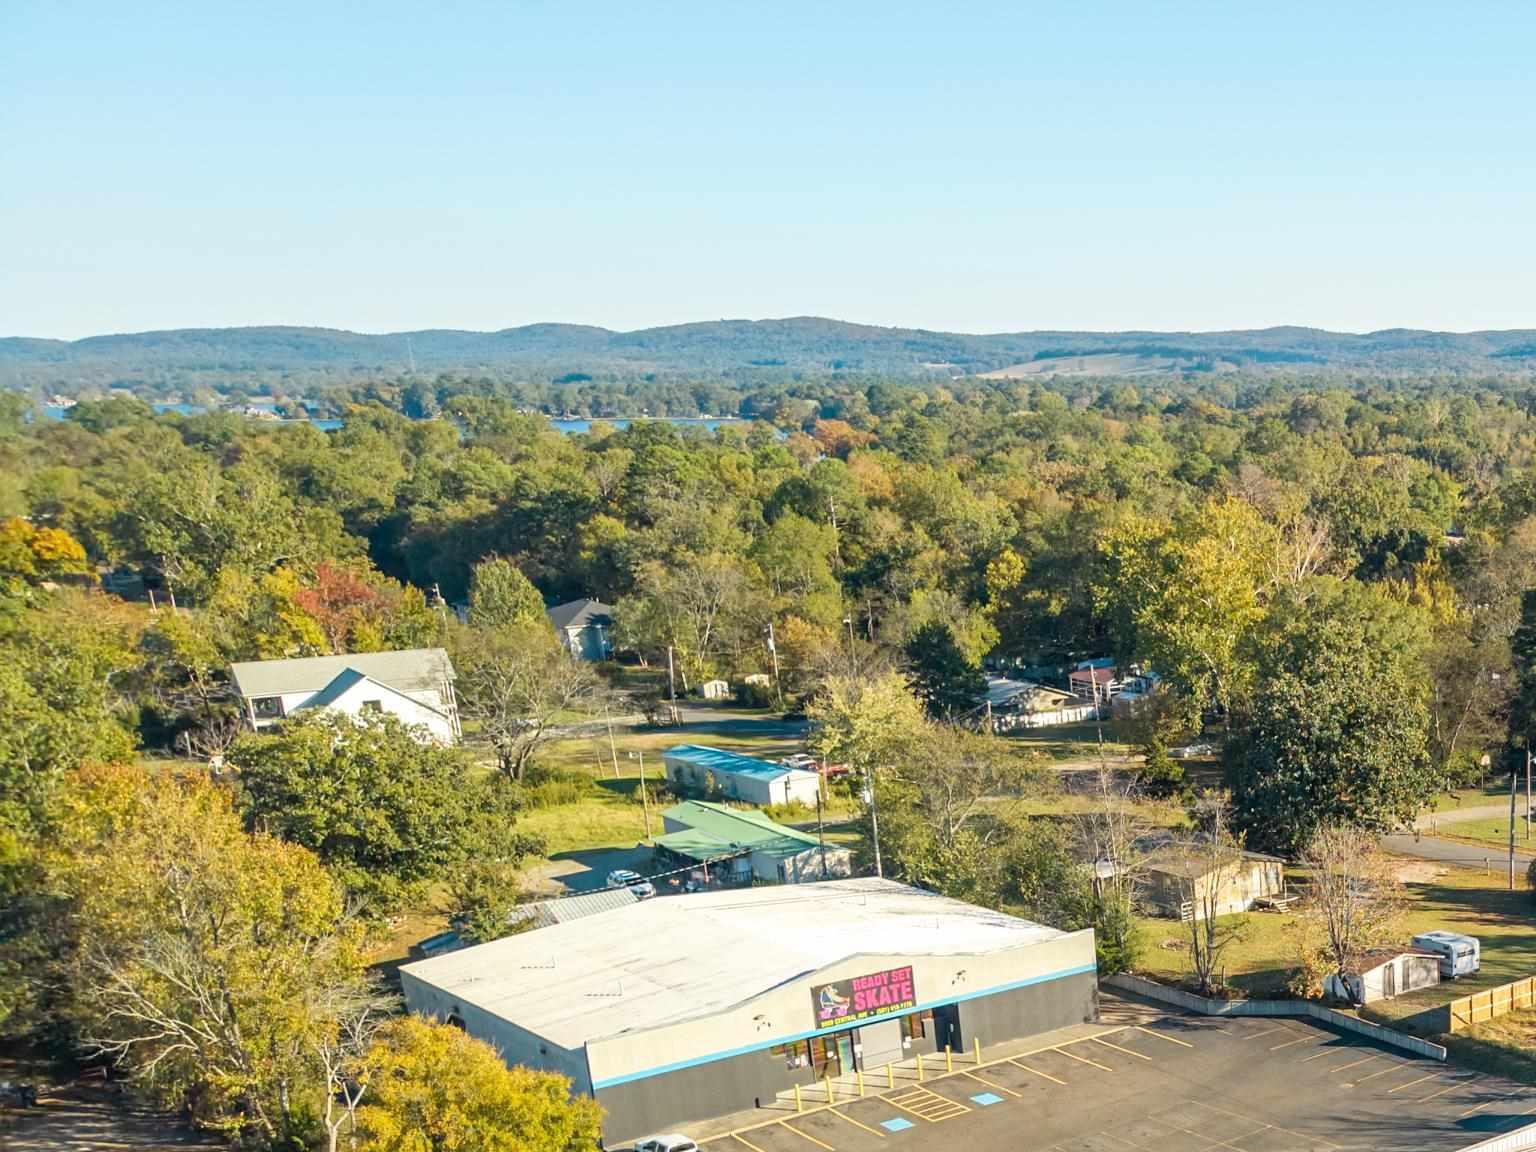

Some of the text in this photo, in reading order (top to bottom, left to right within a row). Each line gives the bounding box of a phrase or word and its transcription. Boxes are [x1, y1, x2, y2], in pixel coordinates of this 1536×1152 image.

[853, 968, 911, 991] READY SET
[854, 982, 913, 1011] SKATE
